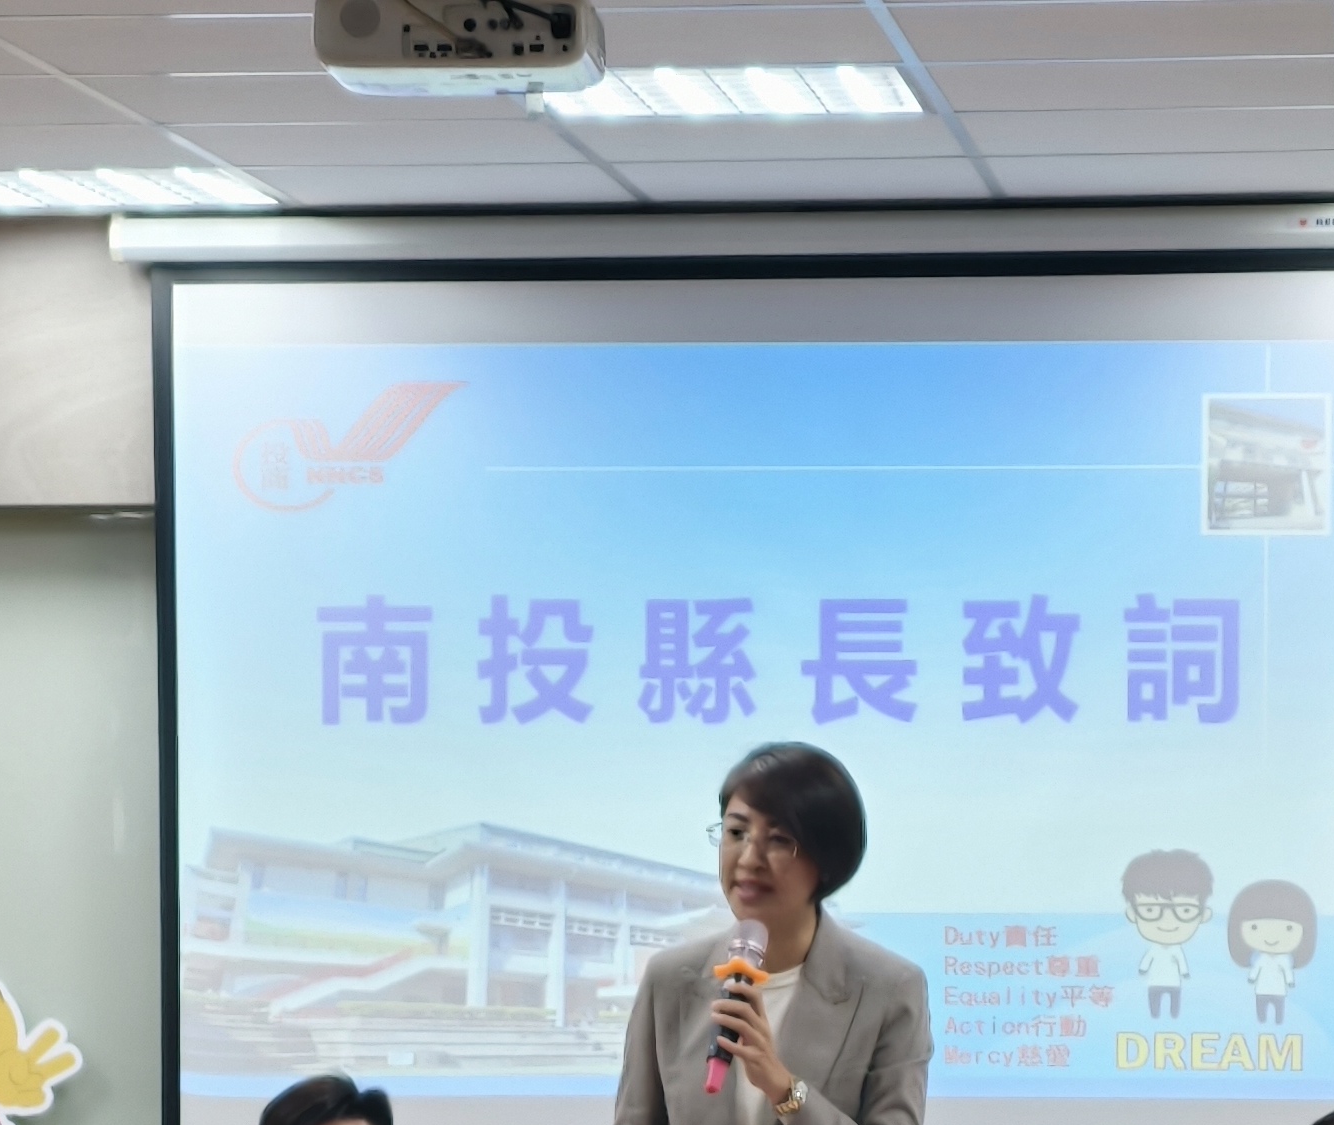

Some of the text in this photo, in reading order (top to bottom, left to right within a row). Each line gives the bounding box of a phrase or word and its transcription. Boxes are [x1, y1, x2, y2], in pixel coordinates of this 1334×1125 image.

[315, 593, 1242, 726] 南投縣長致詞
[944, 985, 1115, 1009] Equality平等
[944, 1015, 1088, 1037] Action行動
[1116, 1032, 1304, 1072] DREAM
